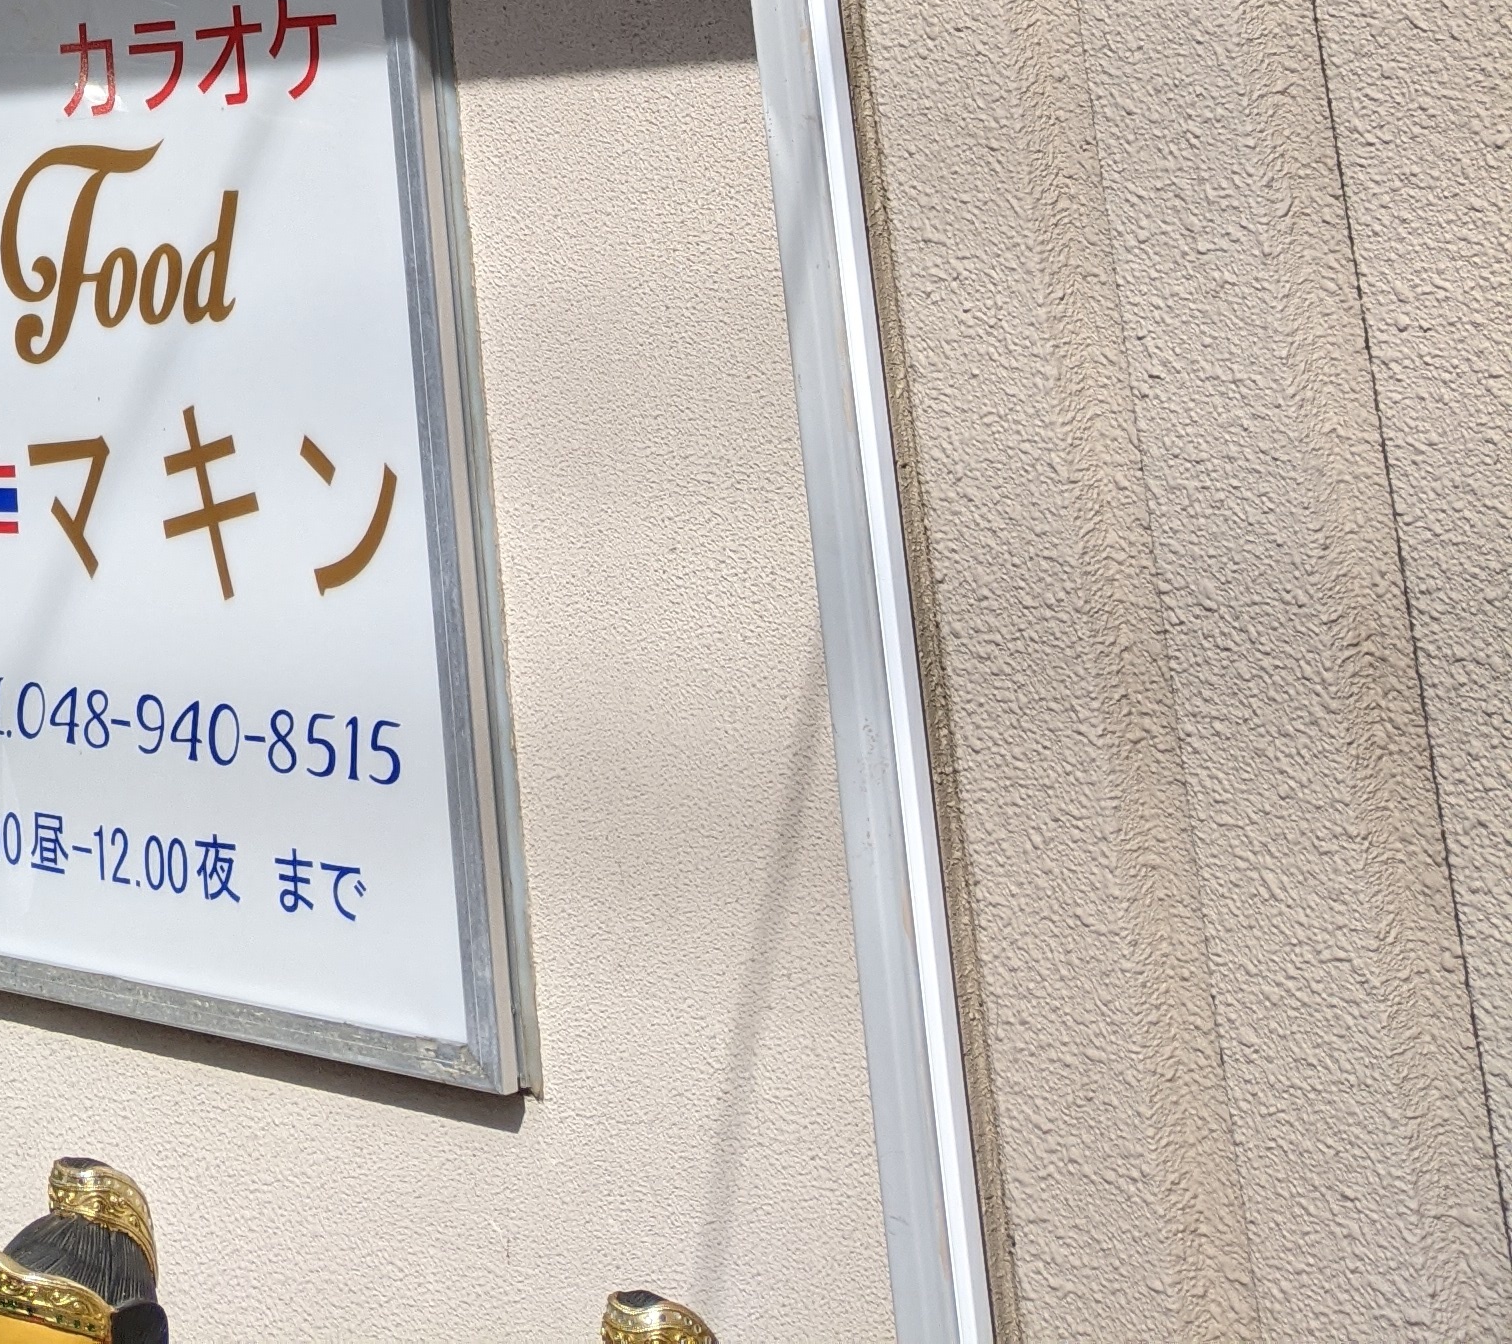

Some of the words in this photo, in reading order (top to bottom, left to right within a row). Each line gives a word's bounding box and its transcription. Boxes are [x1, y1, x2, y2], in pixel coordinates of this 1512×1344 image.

[59, 0, 338, 118] カラオケ
[0, 139, 238, 365] Food
[27, 405, 399, 601] マキン
[273, 847, 368, 923] まで
